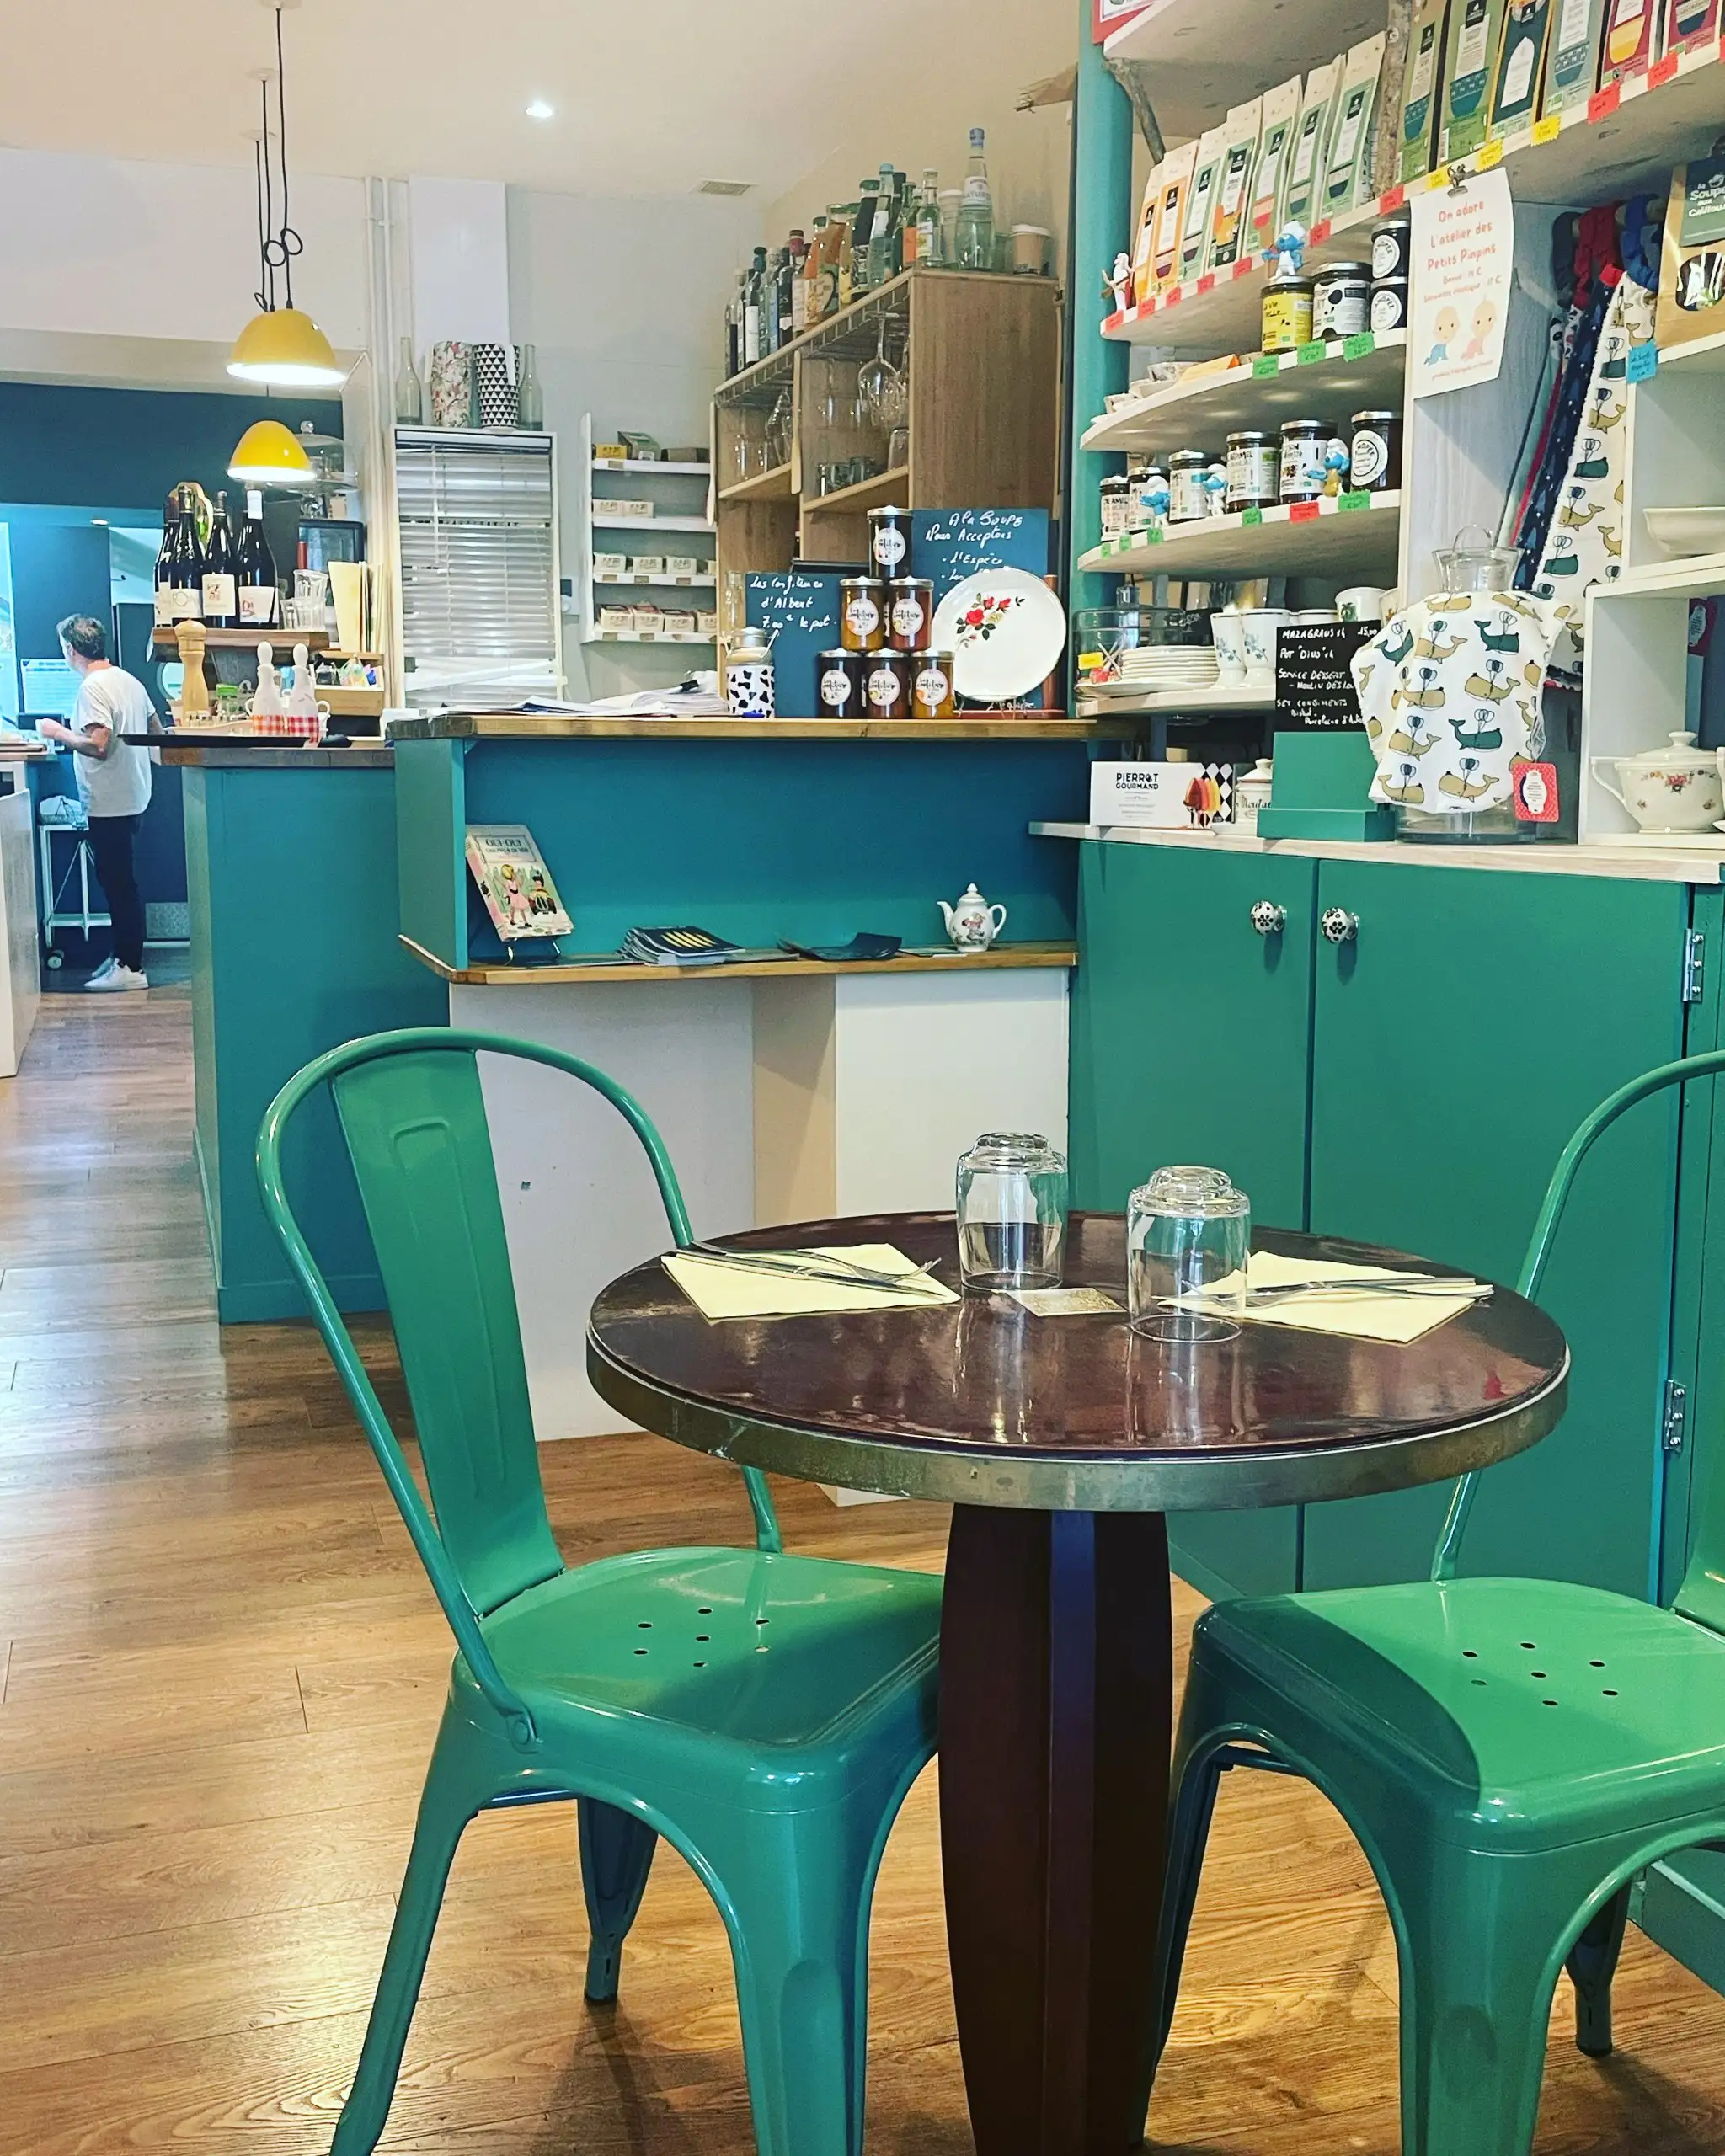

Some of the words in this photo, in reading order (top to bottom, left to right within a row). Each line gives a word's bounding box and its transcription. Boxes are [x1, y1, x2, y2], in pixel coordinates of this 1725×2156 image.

[1439, 211, 1453, 222] On
[1456, 201, 1484, 216] adore
[1431, 228, 1471, 248] L'atelier
[1476, 222, 1493, 234] des
[1428, 255, 1457, 271] Petits
[761, 596, 813, 608] d'Albert
[1115, 782, 1159, 790] GOURMAND
